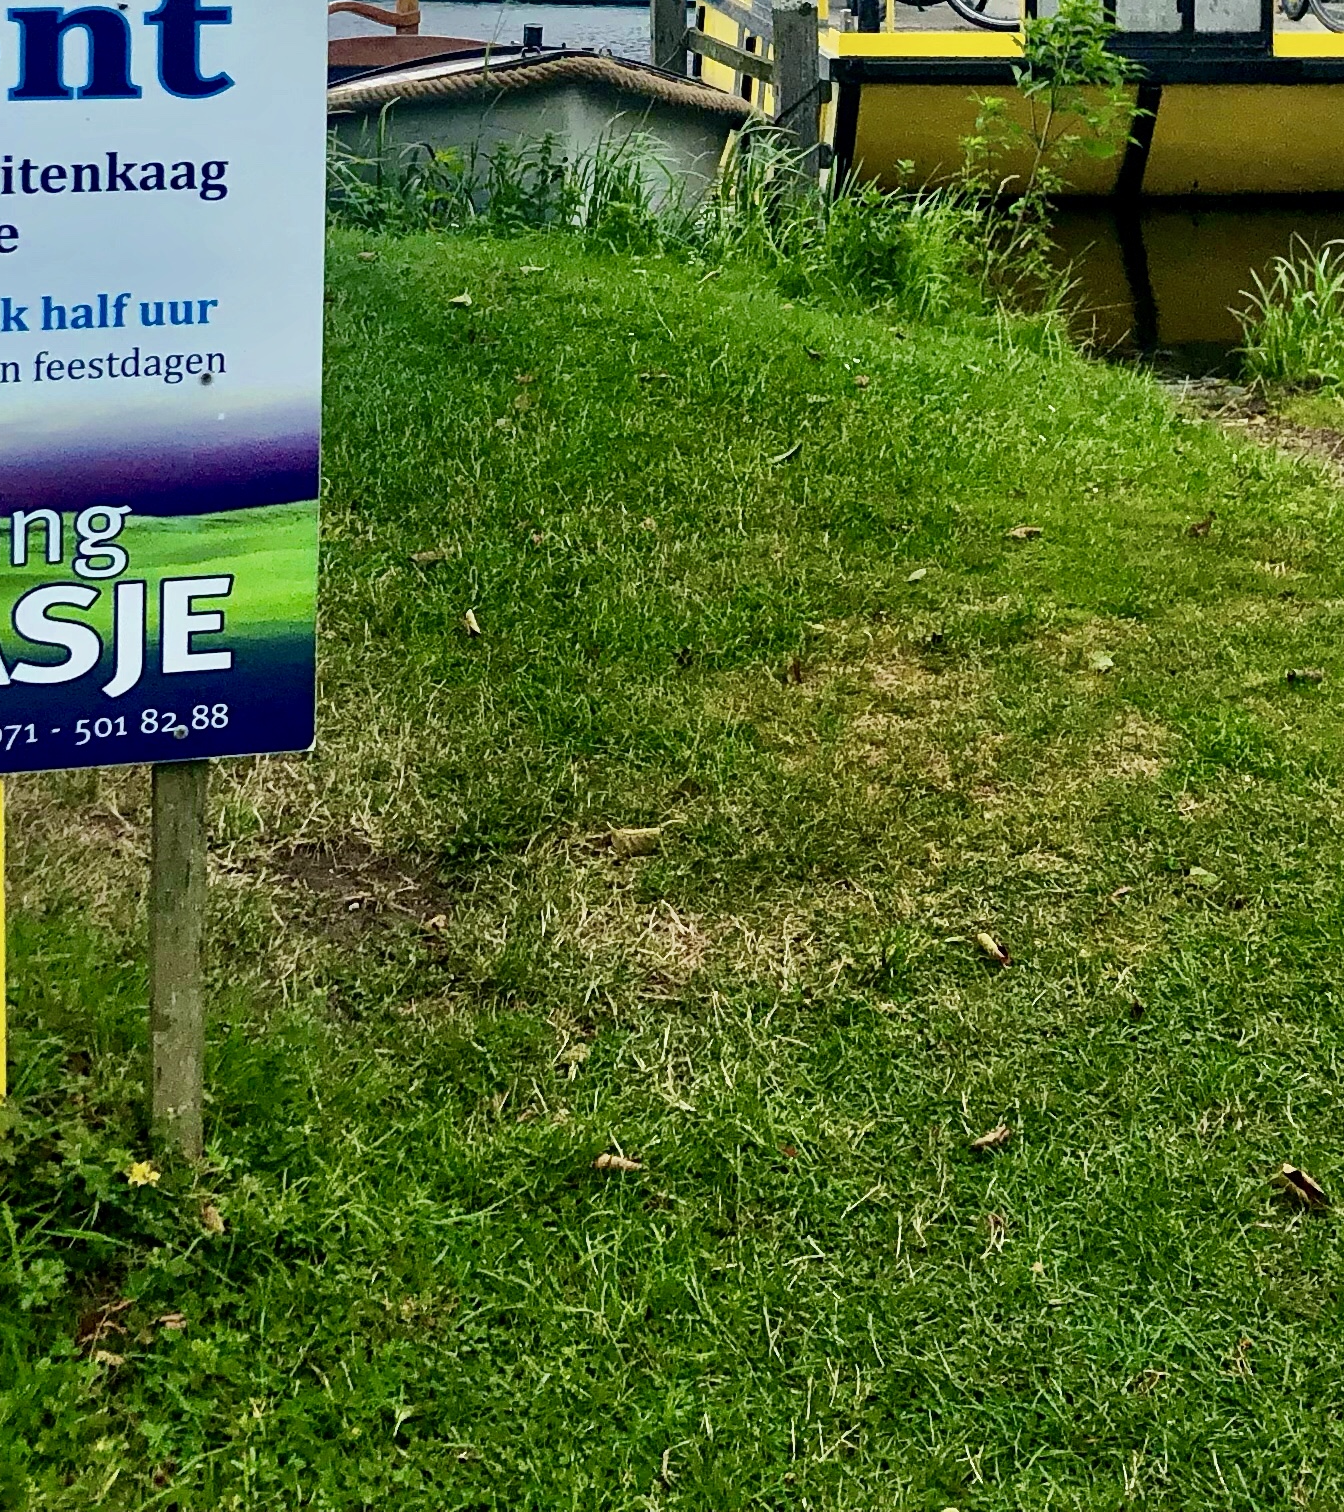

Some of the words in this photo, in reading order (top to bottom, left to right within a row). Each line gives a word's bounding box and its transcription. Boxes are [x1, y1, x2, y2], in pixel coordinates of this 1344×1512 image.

[41, 293, 130, 331] half
[139, 298, 218, 327] uur
[33, 348, 226, 385] feestdagen
[74, 716, 128, 745] 501
[140, 708, 178, 734] 82
[191, 703, 229, 731] 88
